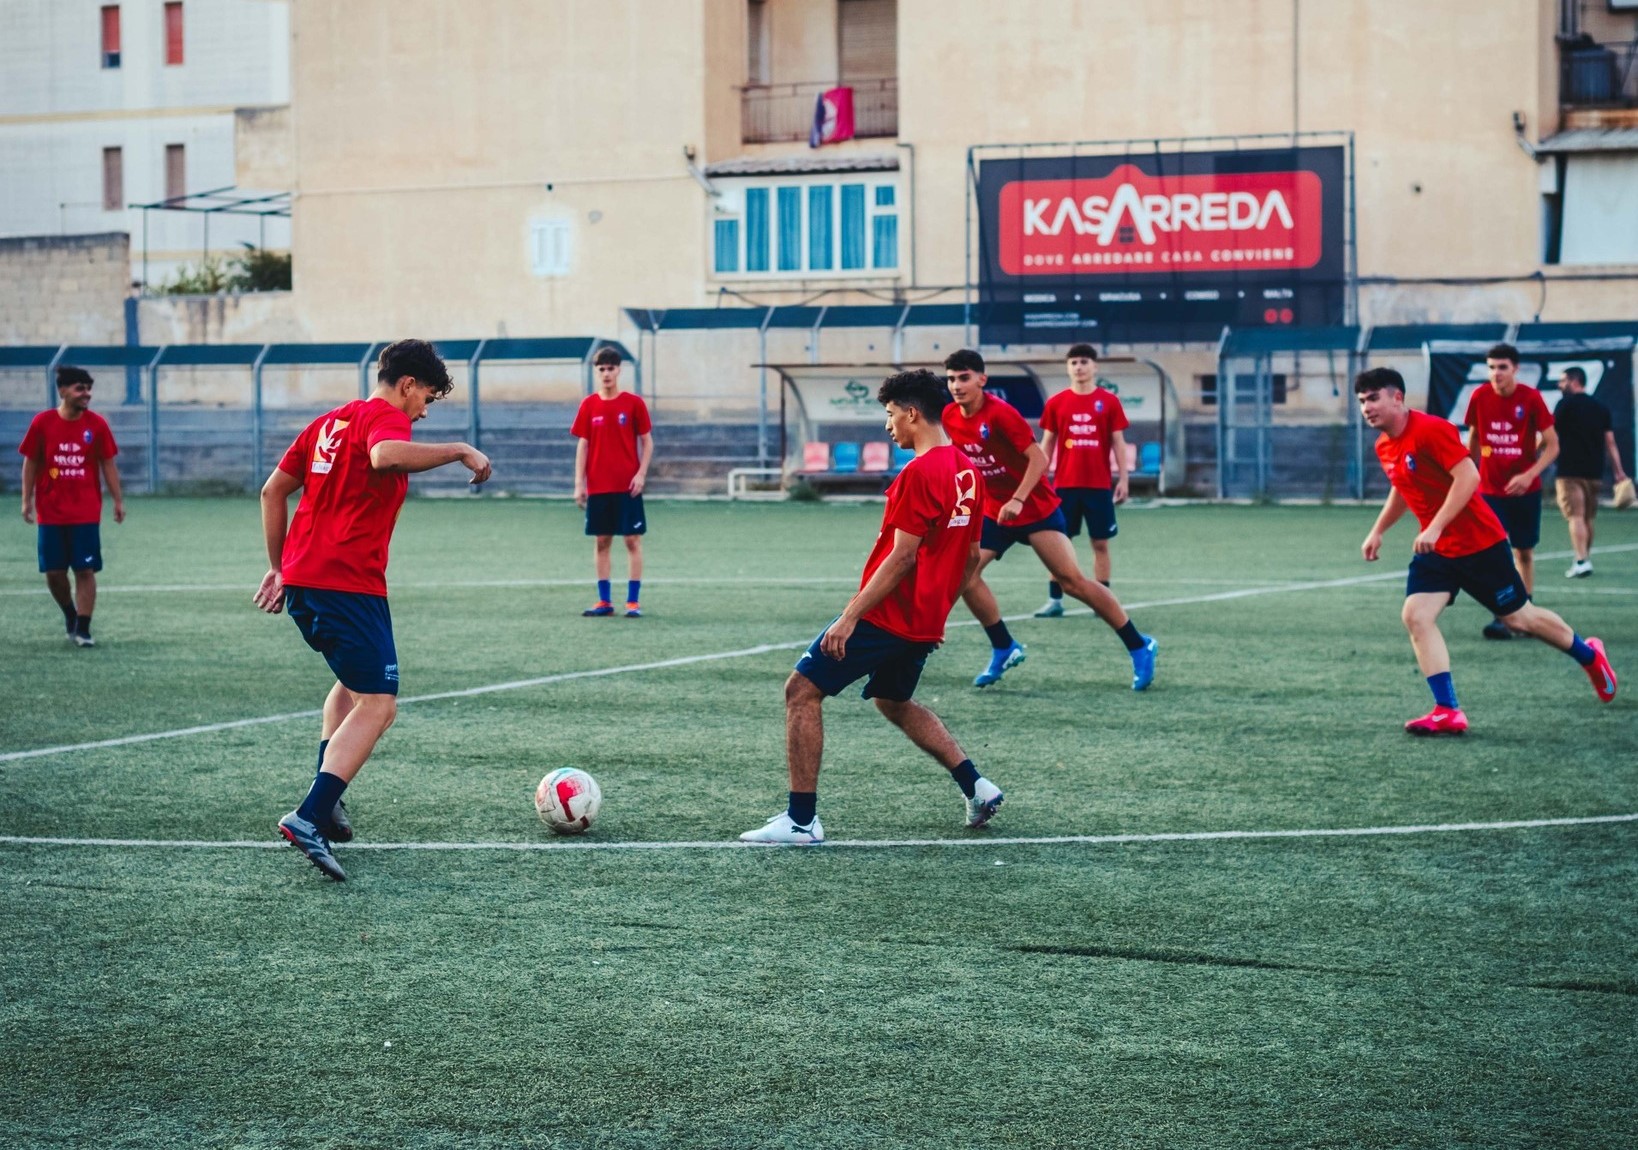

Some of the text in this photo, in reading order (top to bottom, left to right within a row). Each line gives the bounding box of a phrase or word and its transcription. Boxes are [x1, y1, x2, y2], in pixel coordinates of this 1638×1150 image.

[1023, 183, 1294, 246] KASARREDA
[1023, 247, 1294, 267] DOVE ARREDARE CASA CONVIENE
